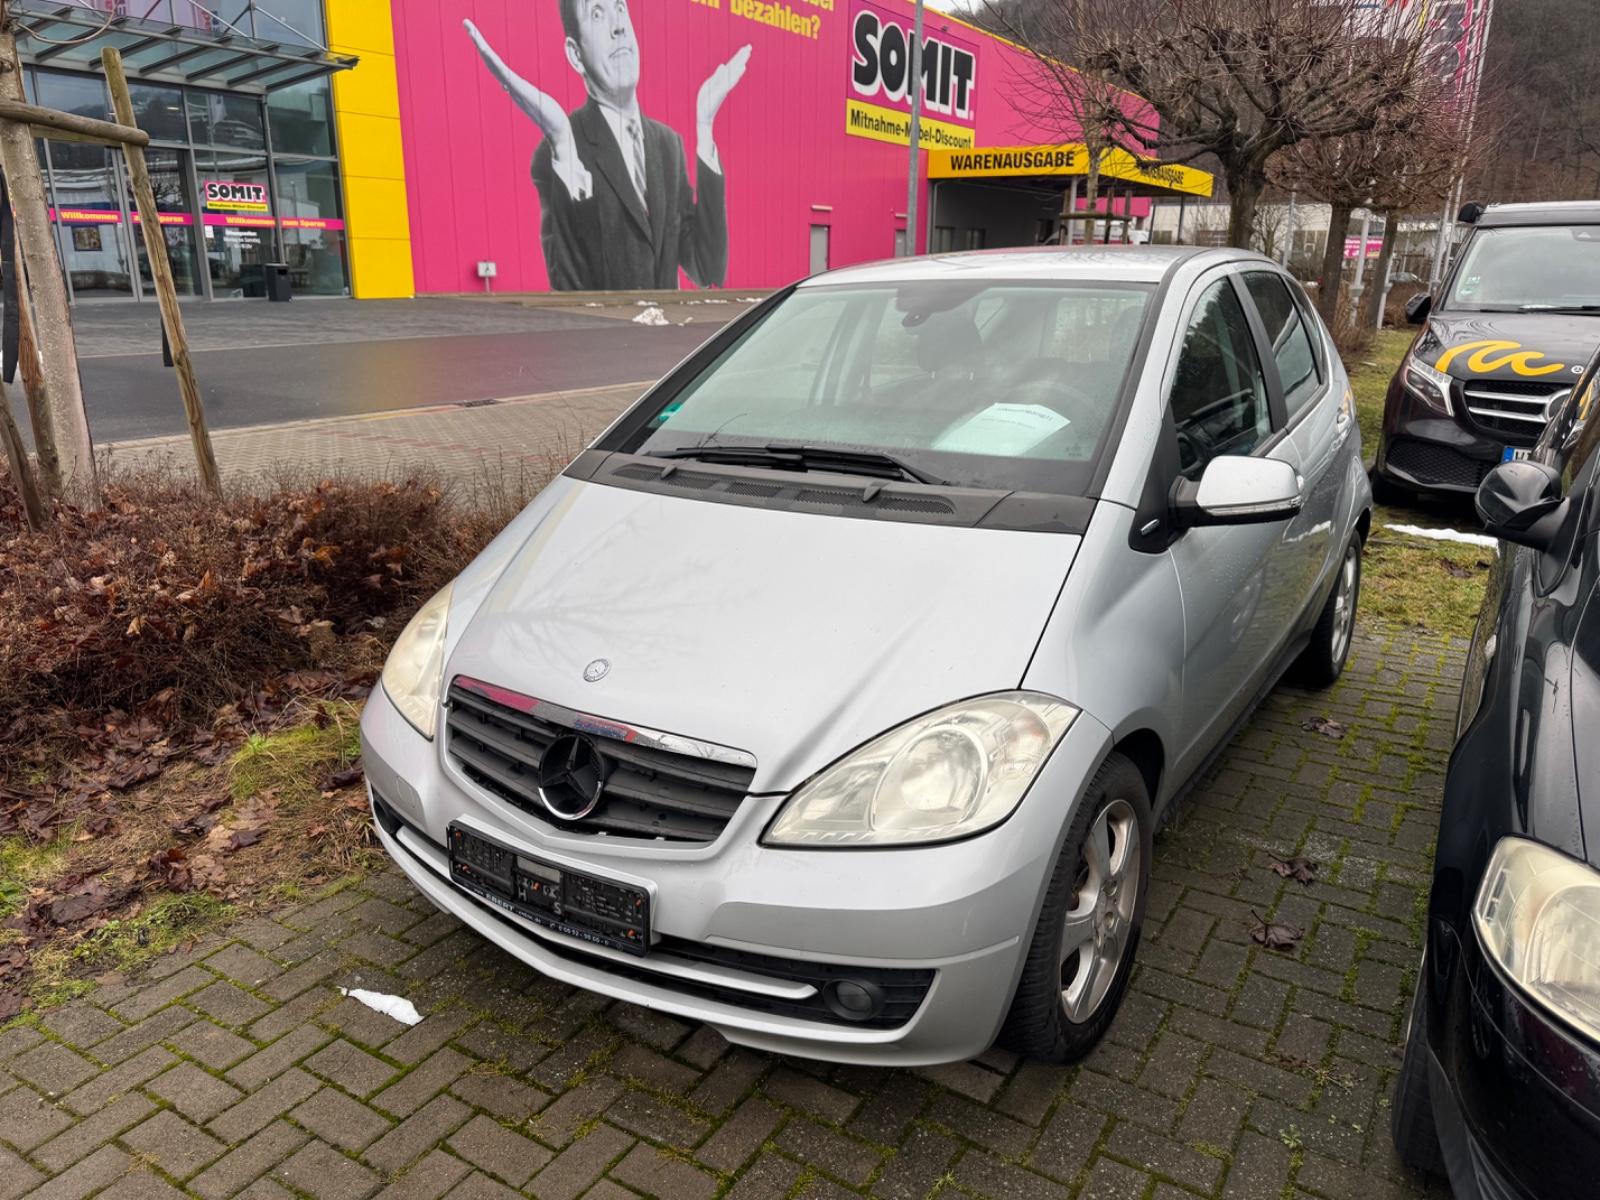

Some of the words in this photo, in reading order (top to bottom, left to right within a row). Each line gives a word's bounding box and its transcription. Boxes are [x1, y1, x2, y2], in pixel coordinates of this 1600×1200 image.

[730, 0, 821, 40] bezahlen?
[851, 11, 975, 117] SOMIT
[850, 108, 972, 150] Mitnahme-Mbel-Discount
[950, 151, 1075, 171] WARENAUSGABE
[206, 183, 263, 201] SOMIT
[60, 210, 119, 222] Willkommen
